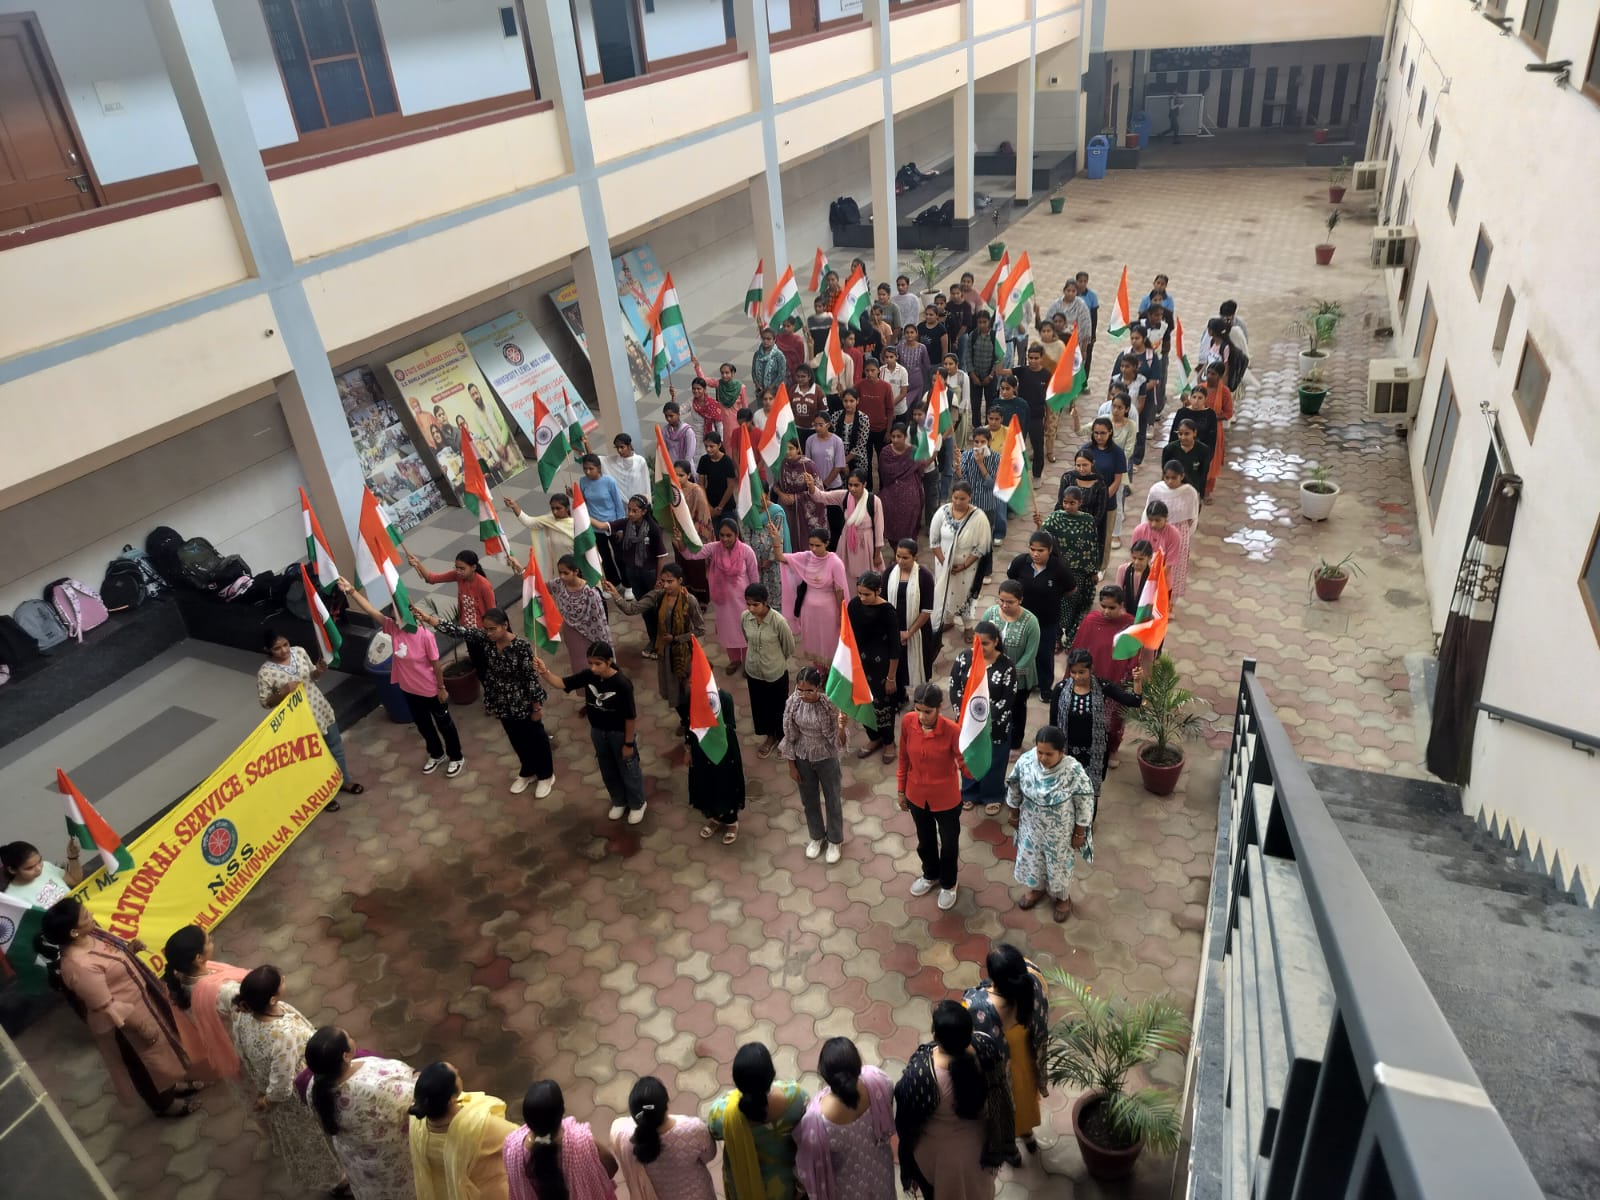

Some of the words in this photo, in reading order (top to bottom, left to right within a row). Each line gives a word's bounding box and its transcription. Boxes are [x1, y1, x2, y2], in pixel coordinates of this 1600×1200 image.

[270, 708, 286, 733] BUT
[286, 689, 304, 712] YOU
[174, 774, 245, 846] SERVICE
[244, 732, 323, 786] SCHEME
[215, 825, 294, 908] MAHAVIDYALYA
